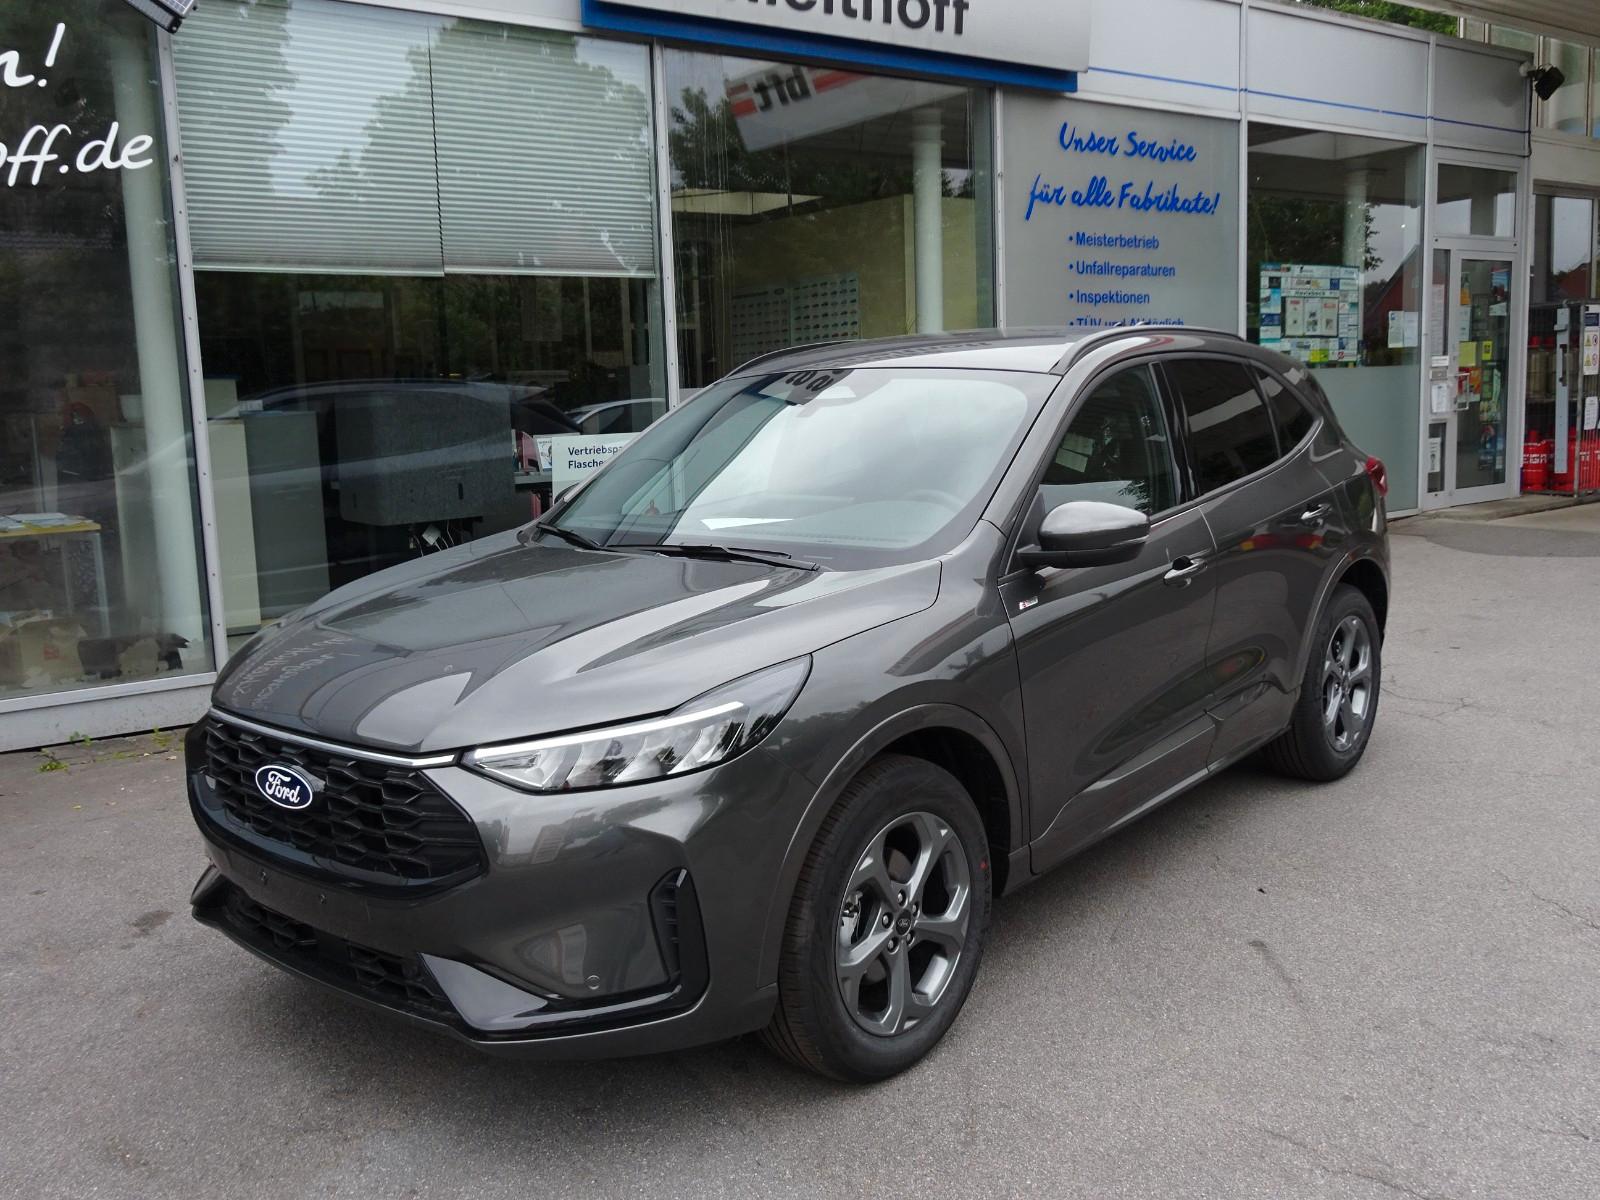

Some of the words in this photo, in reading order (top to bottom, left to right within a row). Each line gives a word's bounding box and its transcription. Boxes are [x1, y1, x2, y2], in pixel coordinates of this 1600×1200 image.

[1059, 121, 1119, 156] Unser
[1123, 131, 1197, 162] Service
[1024, 174, 1066, 221] für
[1072, 175, 1114, 208] alle
[1118, 181, 1220, 215] Fabrikate!
[1075, 232, 1160, 249] Meisterbetrieb
[1075, 261, 1176, 279] Unfallreparaturen
[1075, 289, 1150, 306] Inspektionen
[264, 770, 301, 804] Ford
